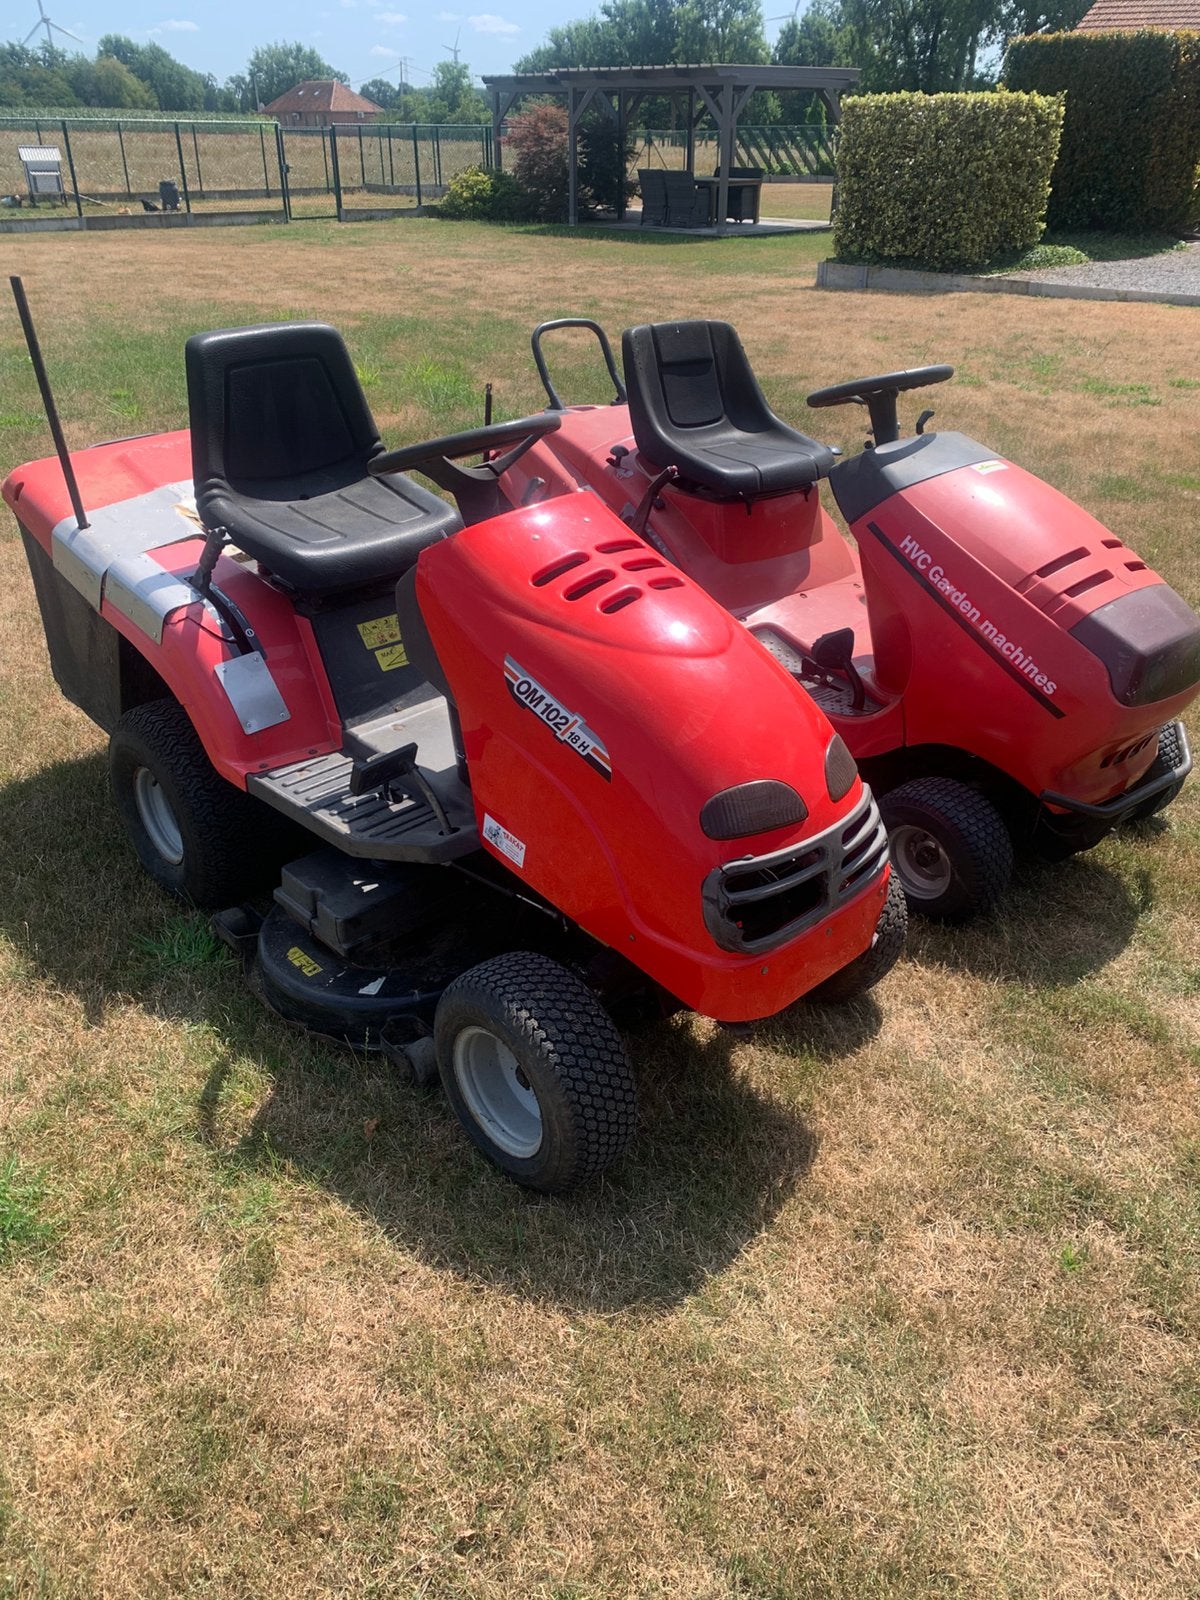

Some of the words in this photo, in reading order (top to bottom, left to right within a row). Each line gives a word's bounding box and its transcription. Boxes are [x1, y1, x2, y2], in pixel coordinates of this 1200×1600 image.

[899, 535, 932, 570] HVC
[928, 565, 981, 622] Garden
[978, 620, 1058, 696] machines
[516, 679, 545, 708] OM
[540, 702, 570, 731] 102
[567, 731, 580, 745] 18
[577, 740, 590, 752] H
